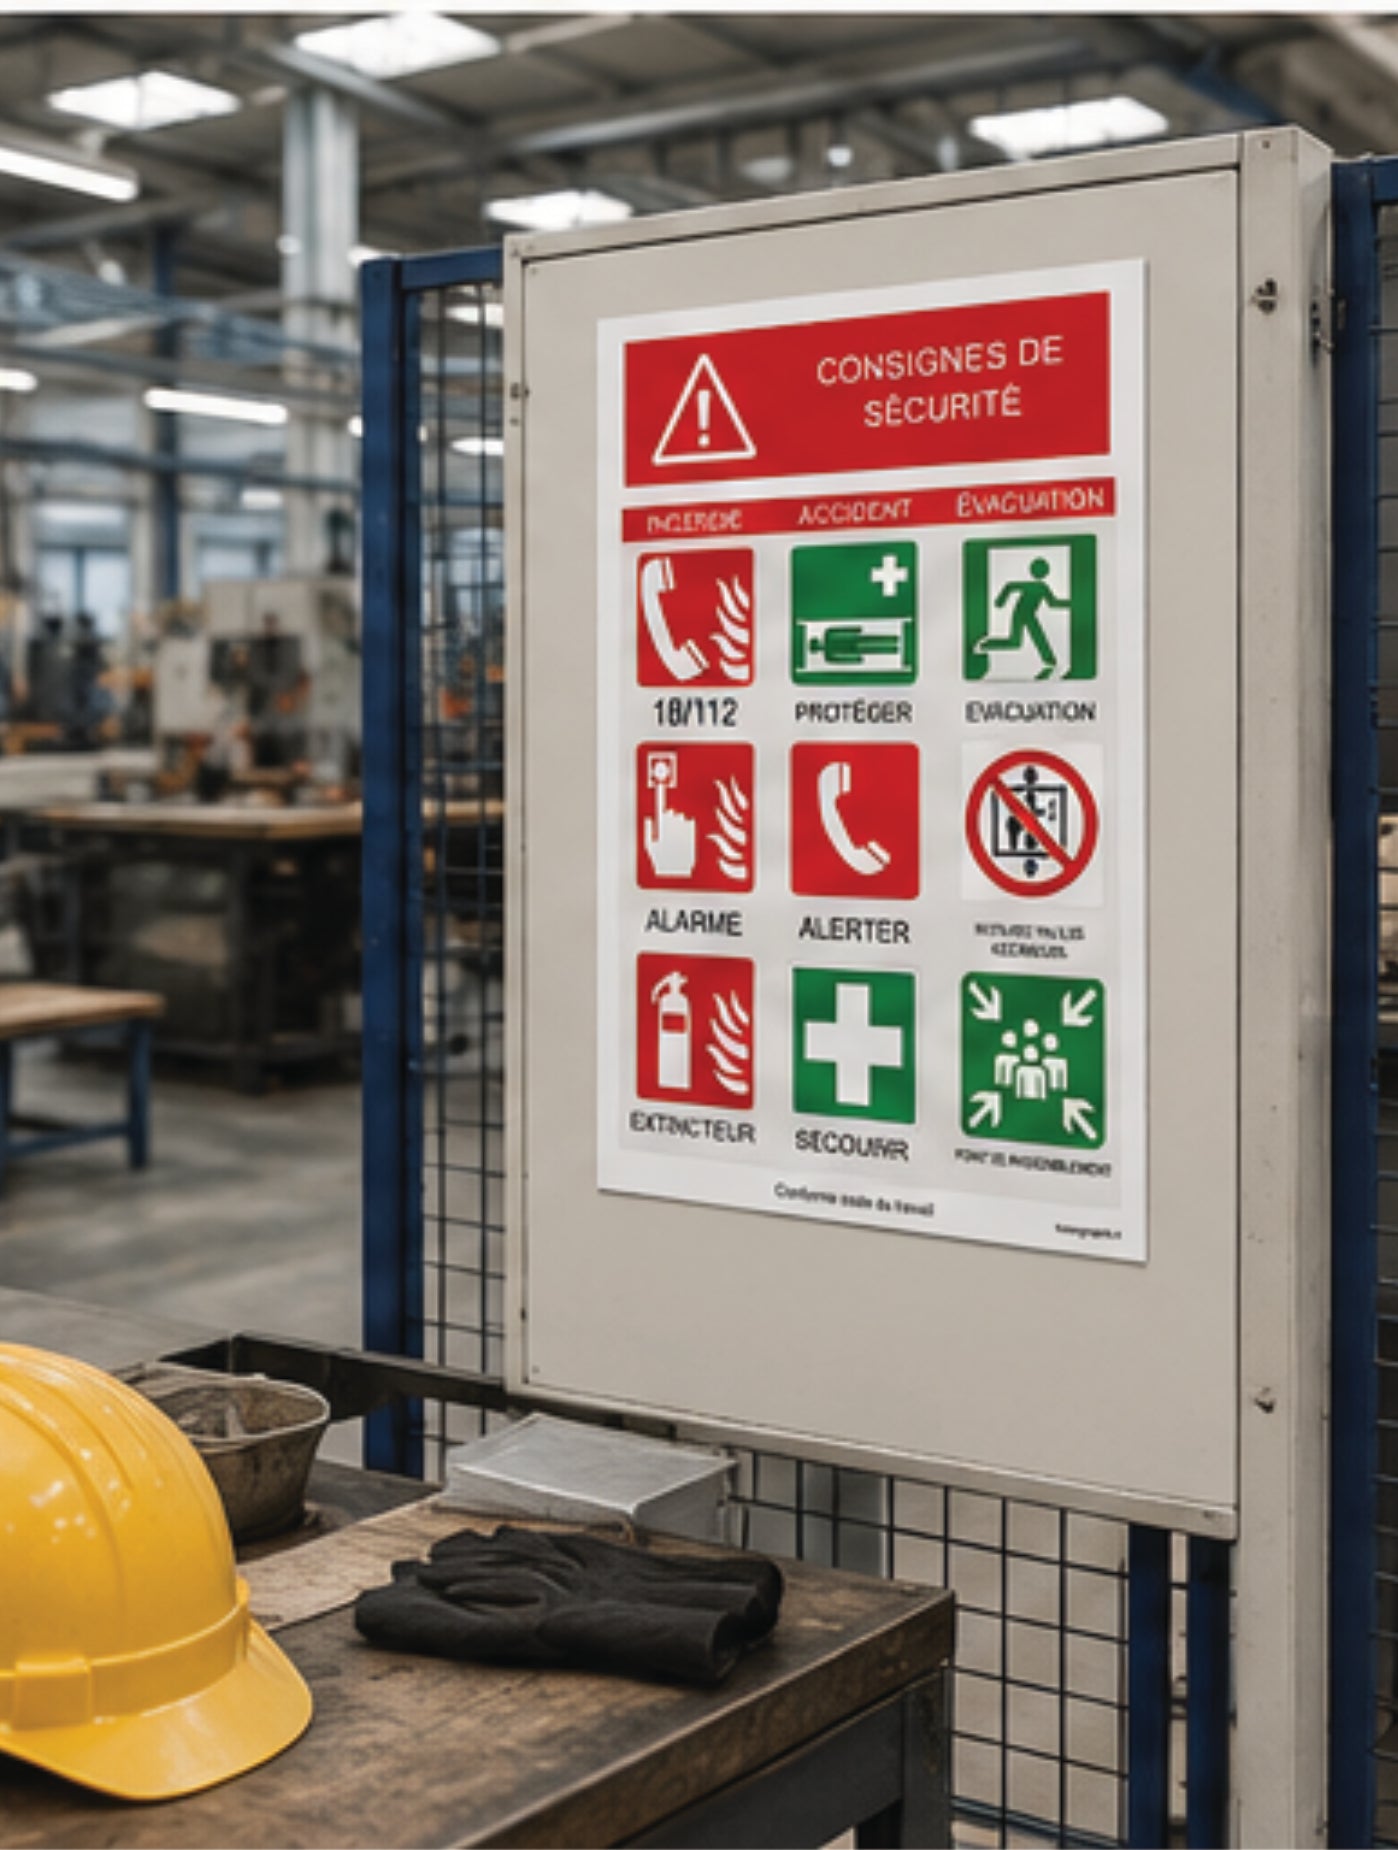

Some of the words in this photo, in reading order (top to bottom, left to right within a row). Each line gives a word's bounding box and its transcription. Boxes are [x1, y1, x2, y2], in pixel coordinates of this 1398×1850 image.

[816, 340, 1007, 386] CONSIGNES
[1018, 334, 1064, 367] DE
[863, 385, 1022, 428] SÉCURITÉ
[797, 498, 912, 526] ACCIDENT
[653, 696, 739, 728] 18/112
[645, 908, 744, 938] ALARME
[798, 915, 911, 945] ALERTER
[629, 1110, 756, 1143] EXTINCTEUR
